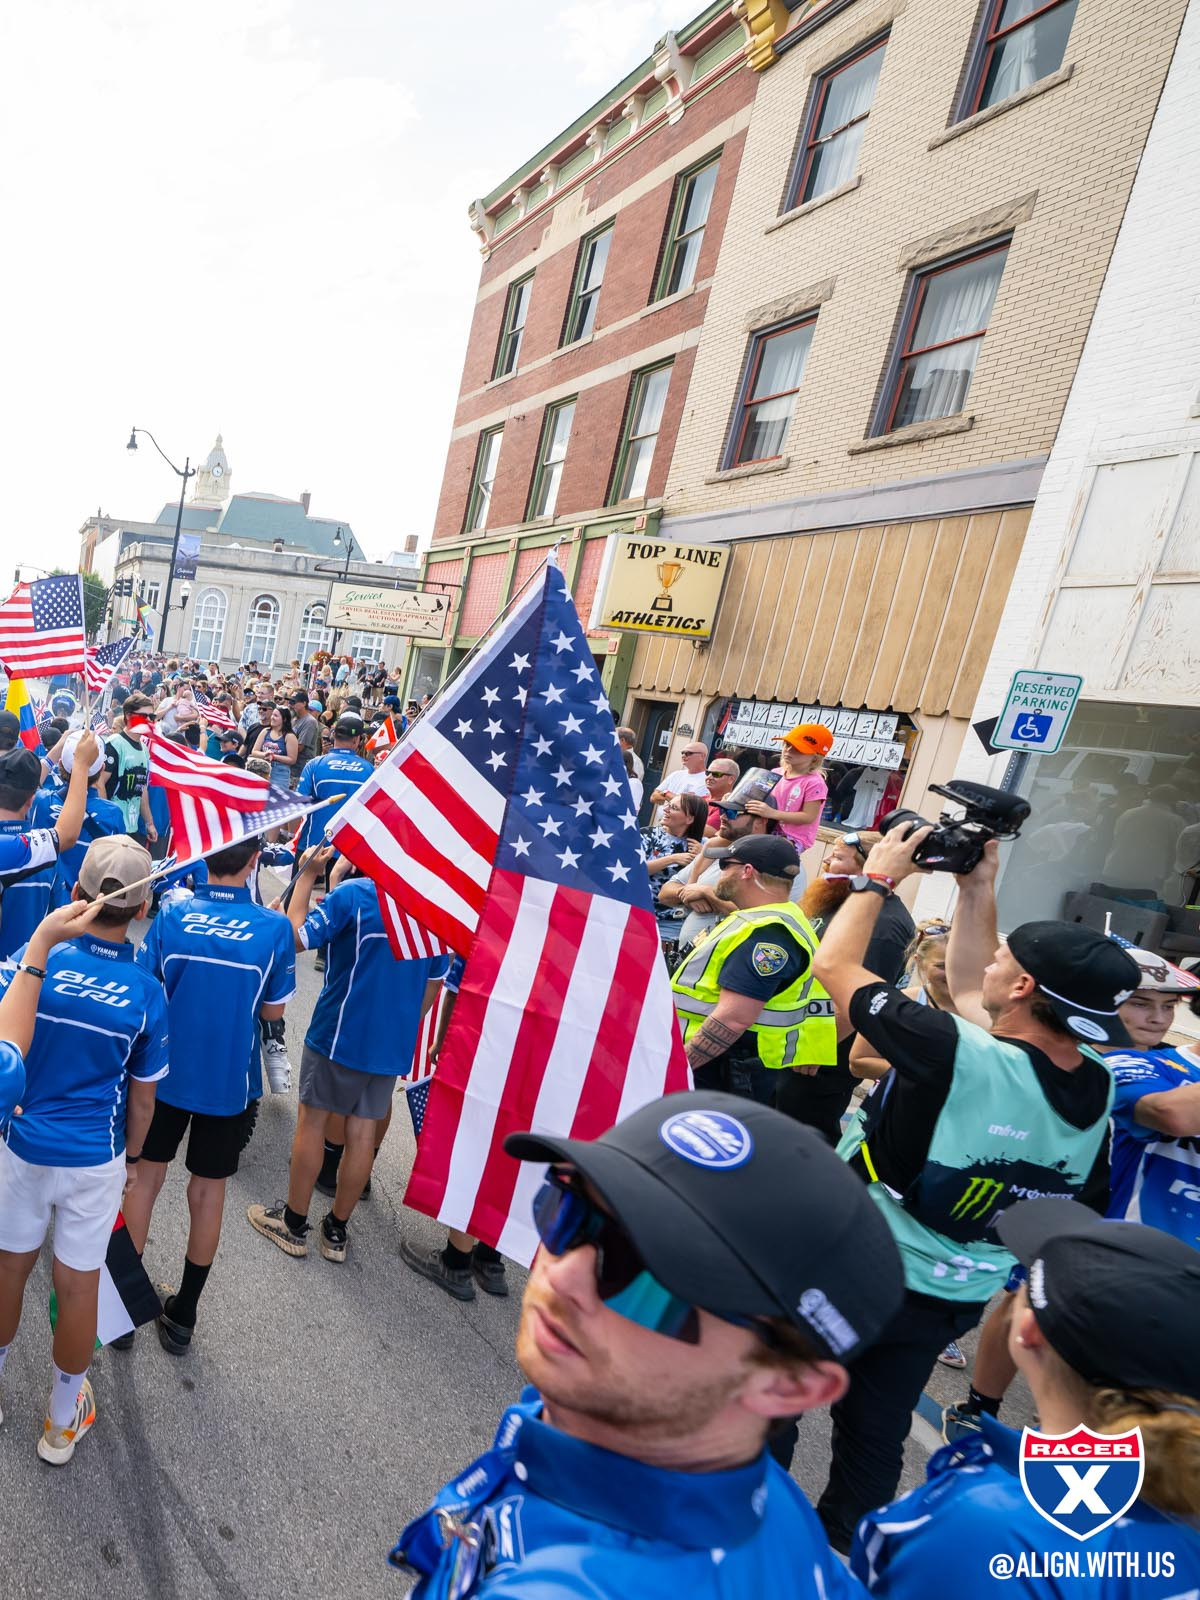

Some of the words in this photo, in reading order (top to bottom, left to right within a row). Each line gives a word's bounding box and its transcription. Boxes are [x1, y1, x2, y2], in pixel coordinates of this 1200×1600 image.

[627, 543, 666, 560] TOP
[674, 547, 722, 568] LINE
[611, 610, 706, 630] ATHLETICS
[1014, 682, 1075, 698] RESERVED
[1011, 695, 1069, 711] PARKING
[754, 706, 874, 734] WELCOME
[831, 741, 882, 762] ANS
[328, 759, 362, 767] BLU
[214, 890, 235, 898] YAMAHA
[181, 912, 250, 929] BLU
[183, 924, 254, 941] CRU
[97, 946, 118, 958] YAMAHA
[52, 969, 130, 994] BLU
[53, 983, 131, 1008] CRU
